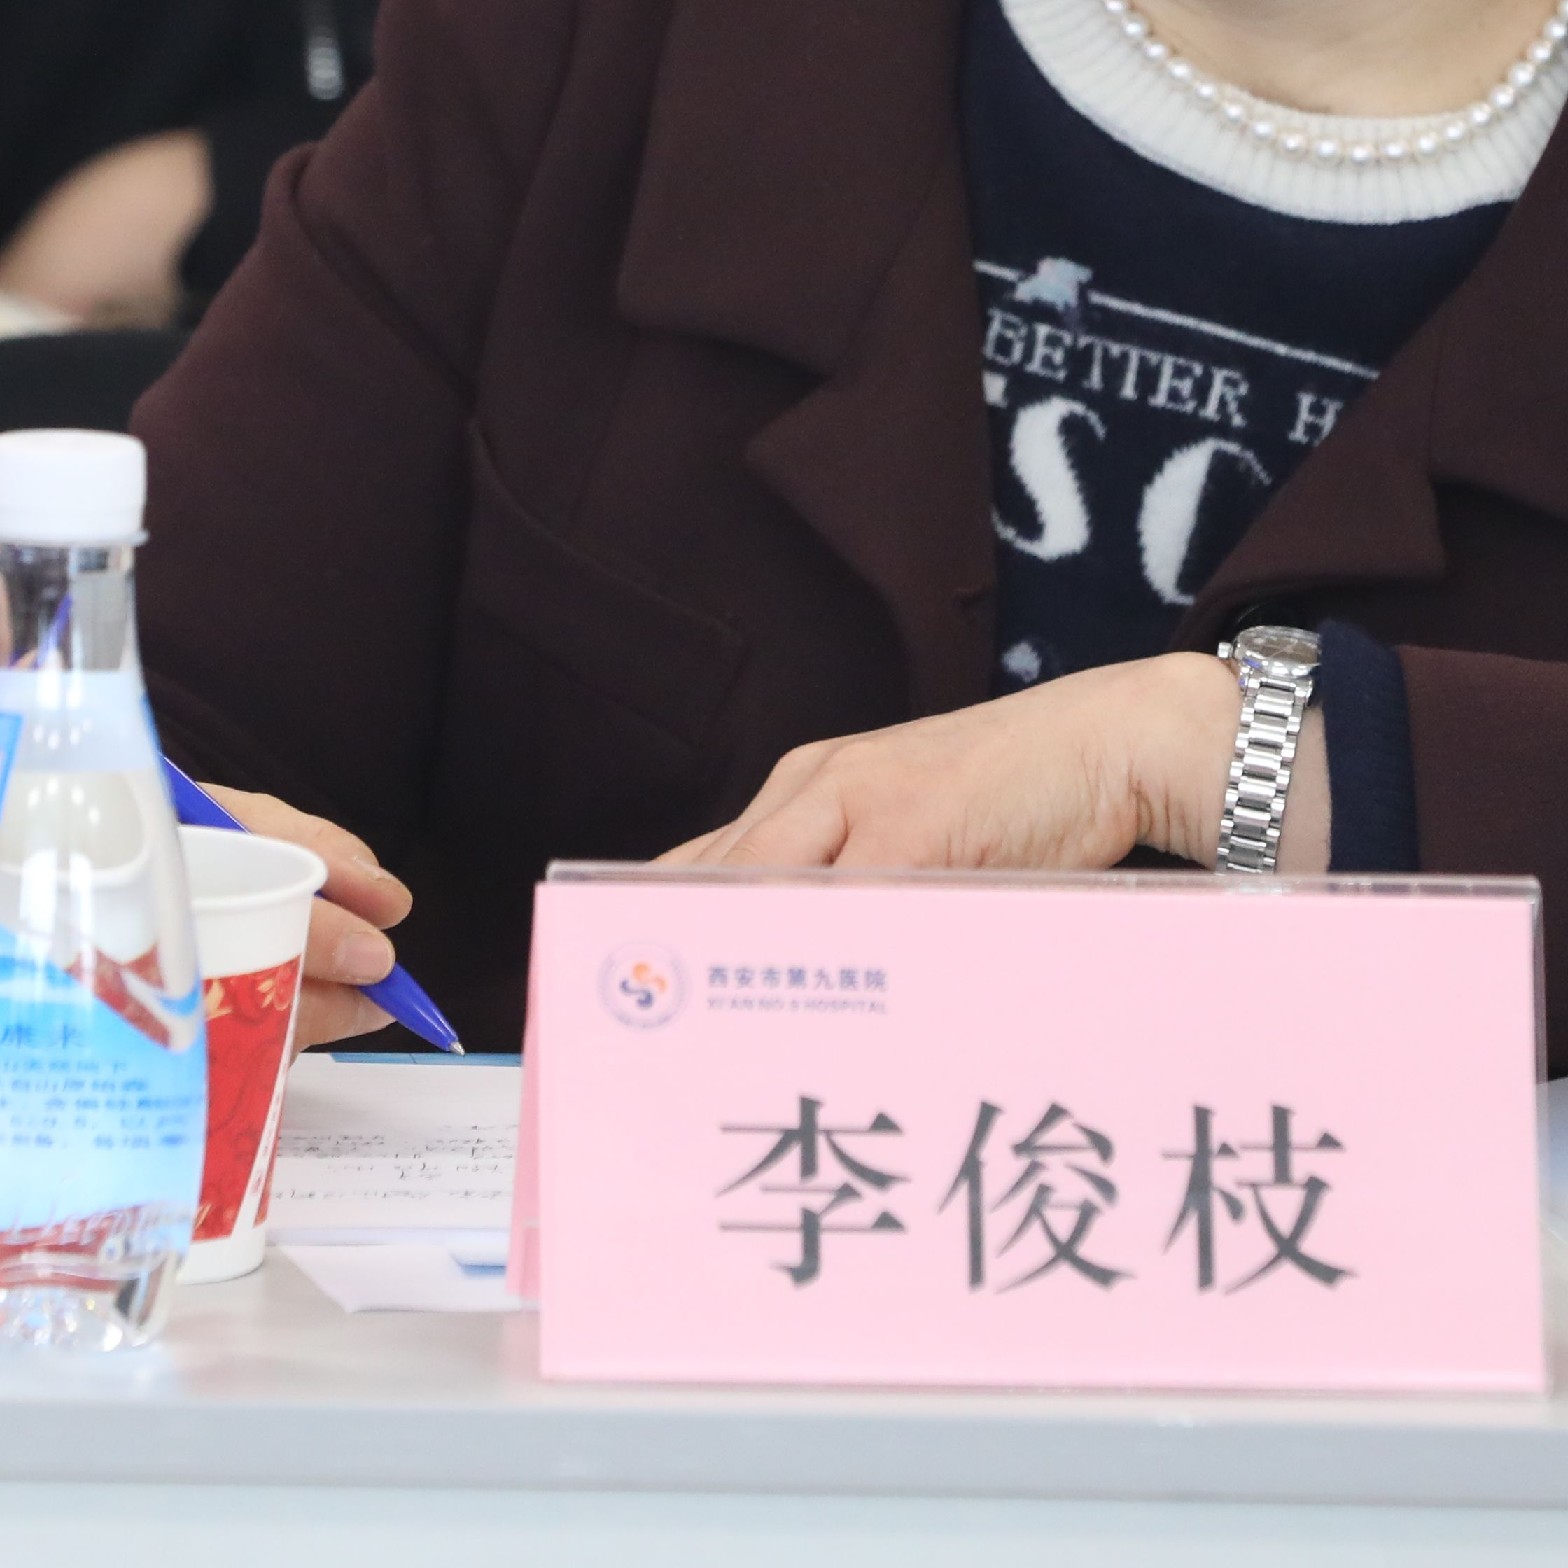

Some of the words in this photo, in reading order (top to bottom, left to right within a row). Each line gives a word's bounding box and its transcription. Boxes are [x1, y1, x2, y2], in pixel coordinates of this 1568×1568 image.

[981, 306, 1250, 428] BETTER
[706, 965, 888, 992] 西安市第九医院
[714, 1093, 1360, 1296] 李俊枝
